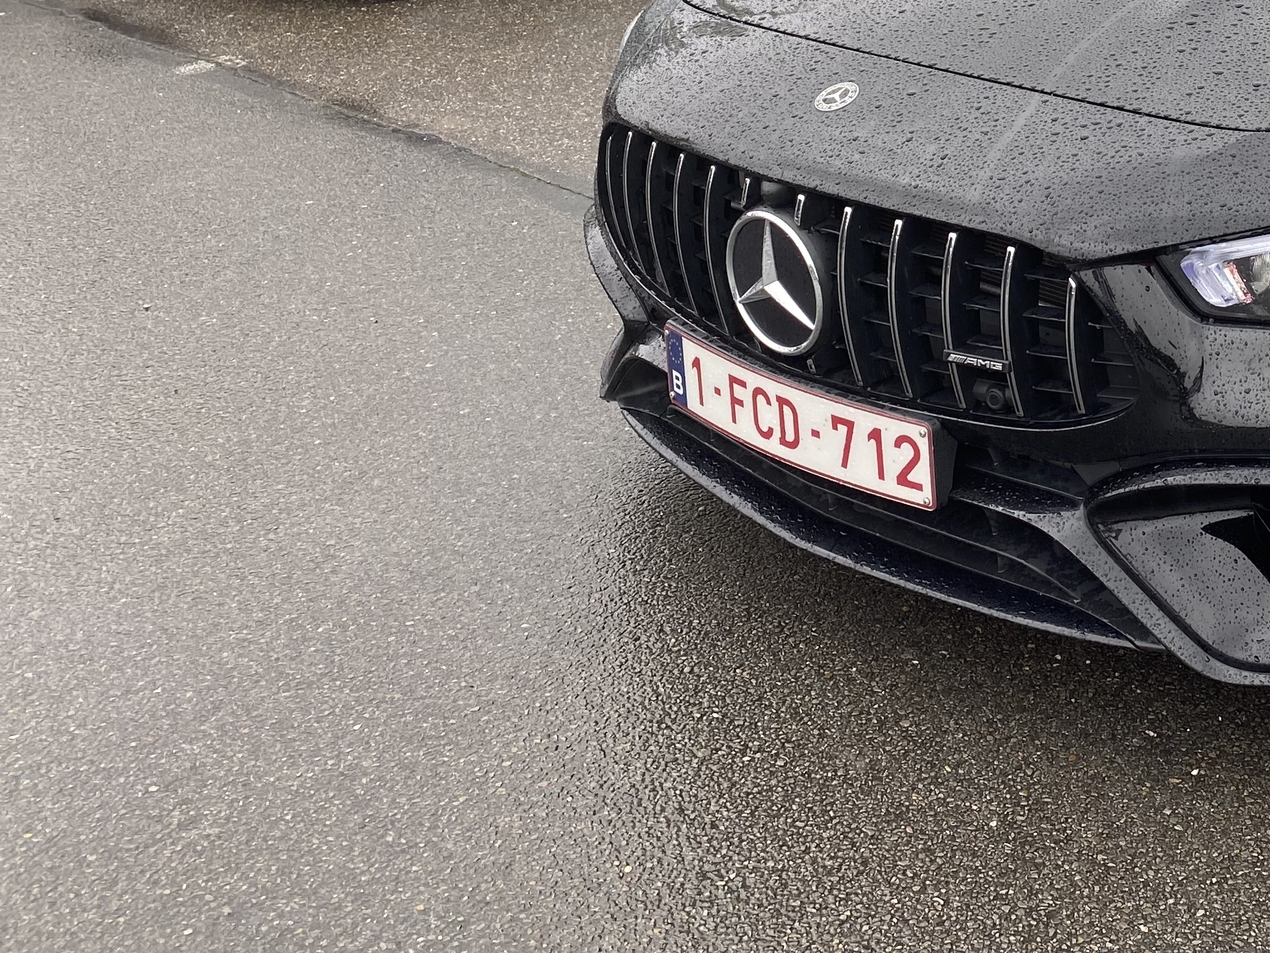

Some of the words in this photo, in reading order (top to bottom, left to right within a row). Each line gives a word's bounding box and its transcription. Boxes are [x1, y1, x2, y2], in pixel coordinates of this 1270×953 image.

[964, 356, 1003, 371] AMG
[672, 370, 684, 395] B
[691, 355, 925, 493] 1-FCD-712
